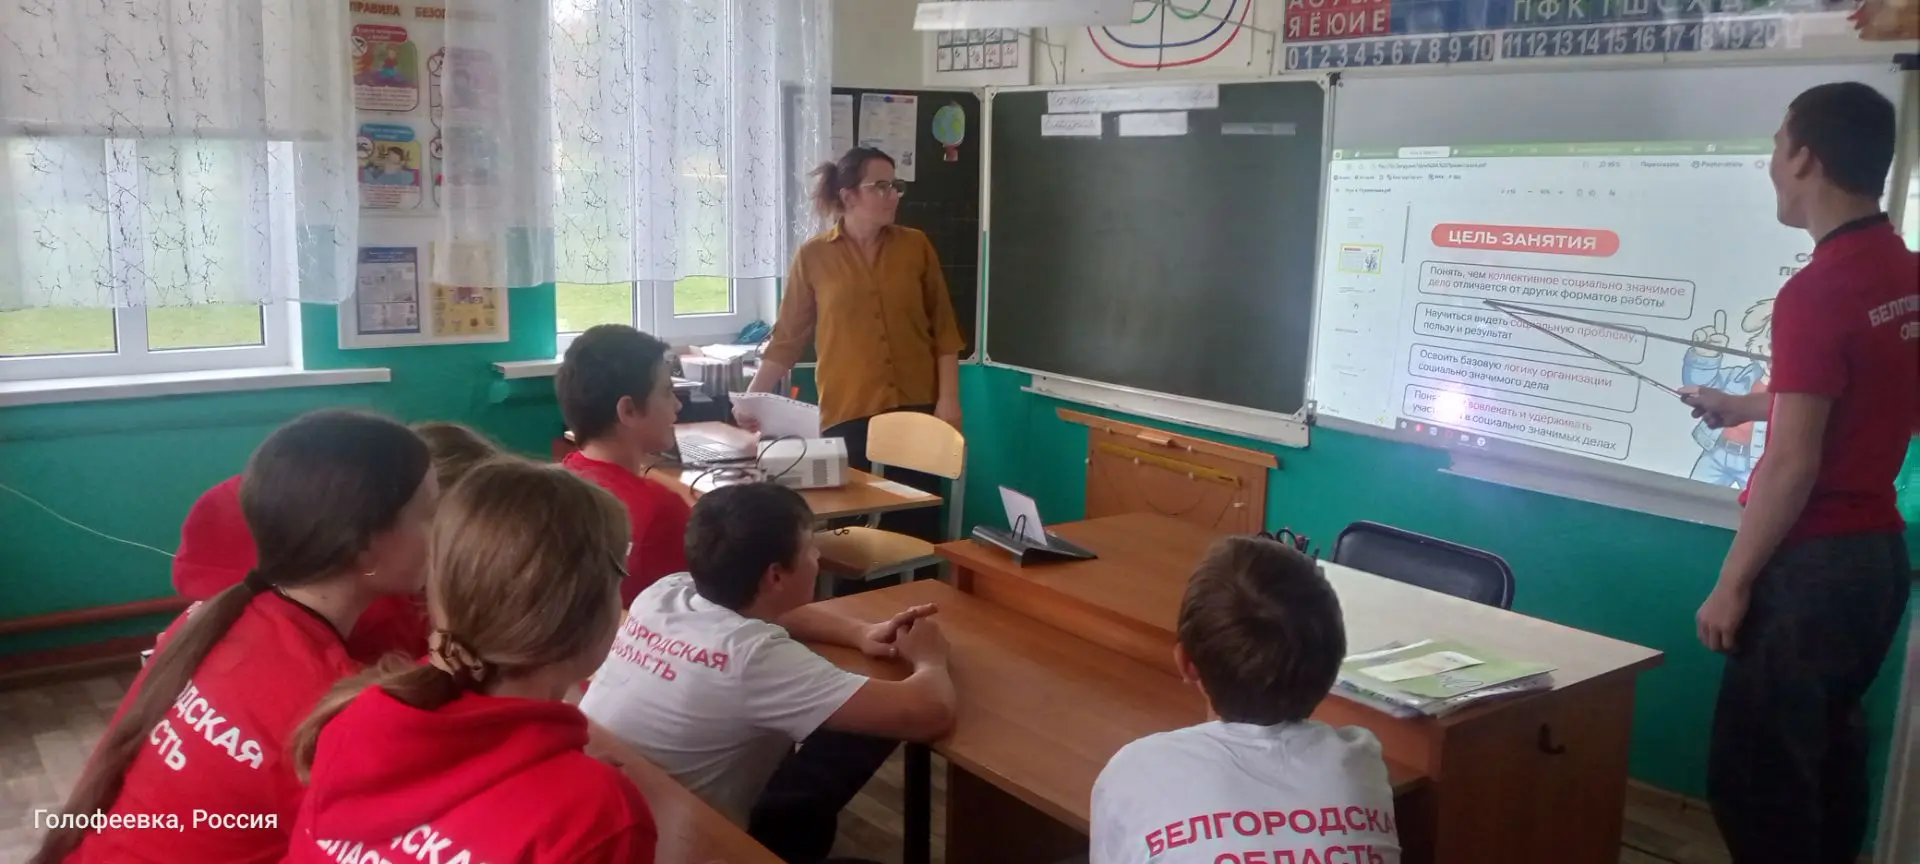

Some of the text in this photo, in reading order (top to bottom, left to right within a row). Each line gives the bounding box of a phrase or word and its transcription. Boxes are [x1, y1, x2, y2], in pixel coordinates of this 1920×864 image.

[1468, 35, 1493, 60] 10
[1504, 32, 1522, 57] 11
[1526, 32, 1547, 56] 12
[1552, 31, 1573, 55] 13
[1578, 30, 1599, 54] 14
[1604, 28, 1627, 53] 15
[1632, 28, 1655, 52] 16
[1662, 26, 1683, 51] 17
[1448, 230, 1597, 250] ЦЕЛЬ ЗАНЯТИЯ
[1428, 278, 1665, 307] дело отличается от других форматов работы
[1430, 266, 1685, 296] Понять, чем коллективное социально значимое
[1423, 321, 1456, 334] пользу
[1464, 327, 1512, 340] результат
[1425, 308, 1638, 343] Научиться видеть социальную проблему,
[1418, 363, 1550, 391] социально значимого дела
[1420, 350, 1612, 387] Освоить базовую логику организации
[1469, 401, 1518, 417] вовлекать
[1529, 412, 1592, 431] удерживать
[1472, 415, 1525, 432] социально
[1528, 426, 1580, 443] значимых
[1582, 436, 1616, 450] делах
[1145, 806, 1397, 857] БЕЛГОРОДСКА
